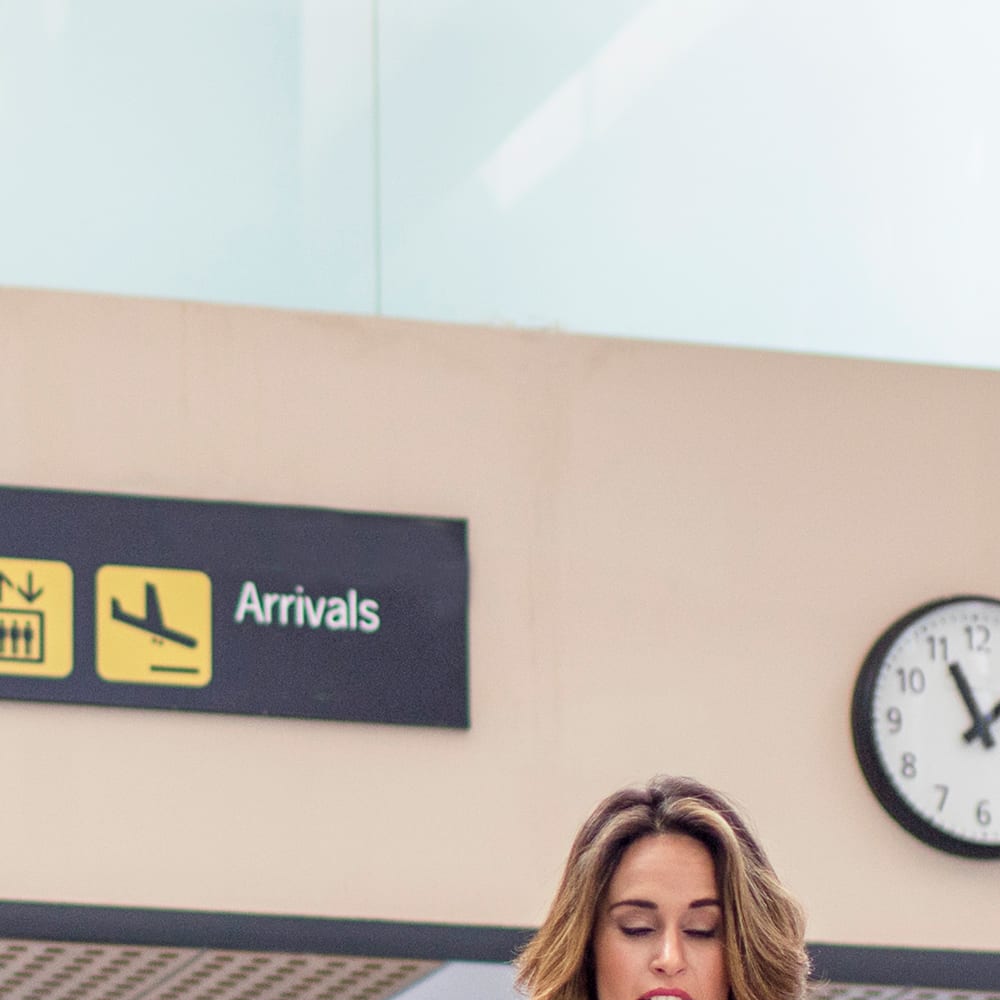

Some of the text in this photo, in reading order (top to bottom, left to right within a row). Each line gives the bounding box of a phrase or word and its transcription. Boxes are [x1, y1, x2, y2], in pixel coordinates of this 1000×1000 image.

[236, 581, 380, 632] Arrivals
[927, 636, 949, 661] 11
[964, 625, 991, 652] 12
[897, 668, 926, 694] 10
[887, 707, 902, 734] 9
[902, 752, 917, 779] 8
[935, 784, 949, 811] 7
[975, 800, 991, 826] 6
